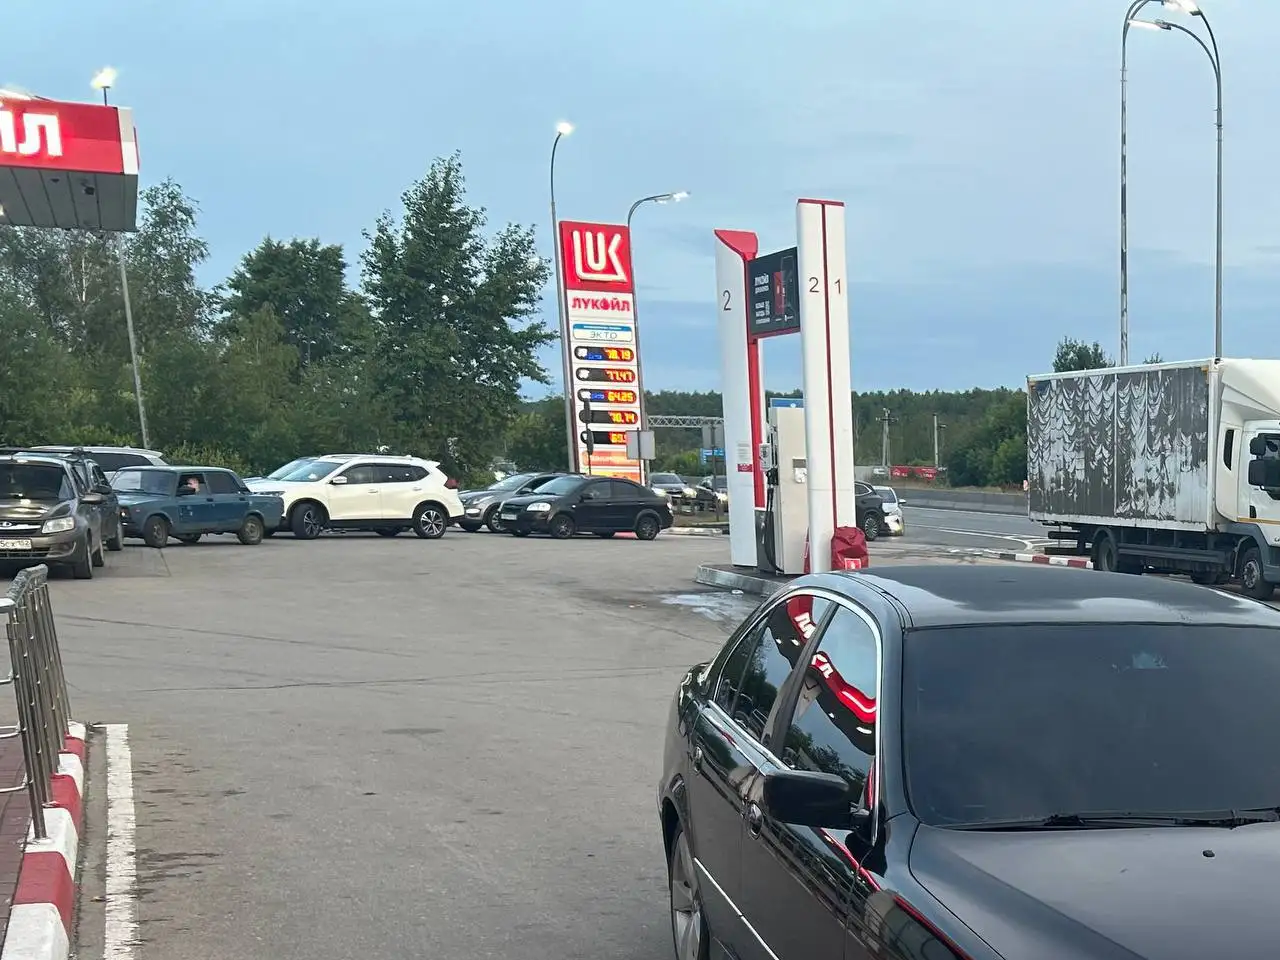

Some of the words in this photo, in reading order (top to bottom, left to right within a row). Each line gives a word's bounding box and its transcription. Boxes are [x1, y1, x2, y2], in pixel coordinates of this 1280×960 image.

[807, 276, 819, 293] 2
[834, 279, 842, 294] 1
[571, 297, 630, 311] ЛУКОЙЛ
[722, 290, 732, 311] 2
